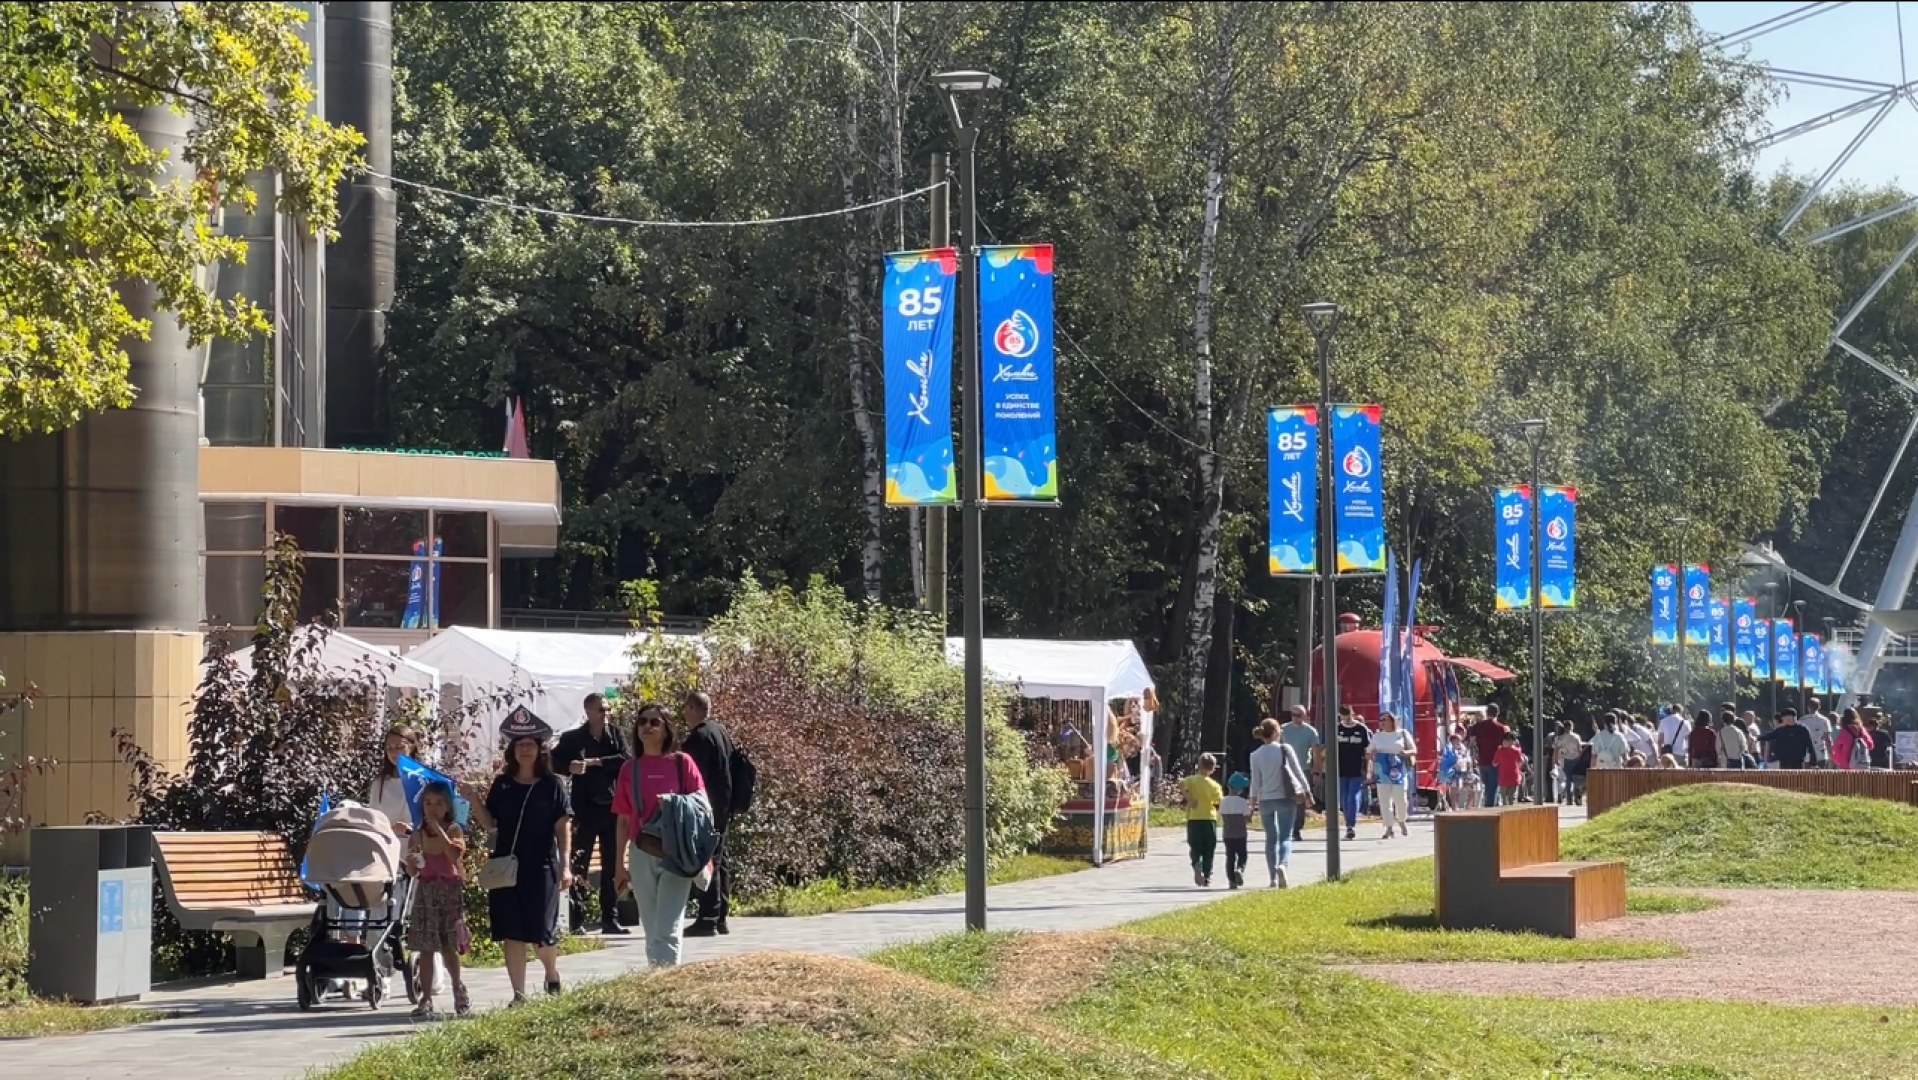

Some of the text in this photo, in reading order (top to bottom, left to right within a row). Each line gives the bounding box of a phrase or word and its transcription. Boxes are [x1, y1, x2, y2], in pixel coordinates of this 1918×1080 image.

[898, 285, 942, 317] 85
[907, 318, 935, 331] ЛЕТ
[1008, 336, 1021, 345] 85
[992, 362, 1039, 382] Химки
[906, 349, 933, 425] Химки
[1005, 393, 1029, 401] УСПЕХ
[1277, 431, 1308, 452] 85
[1502, 503, 1524, 519] 85
[1656, 576, 1673, 587] 85
